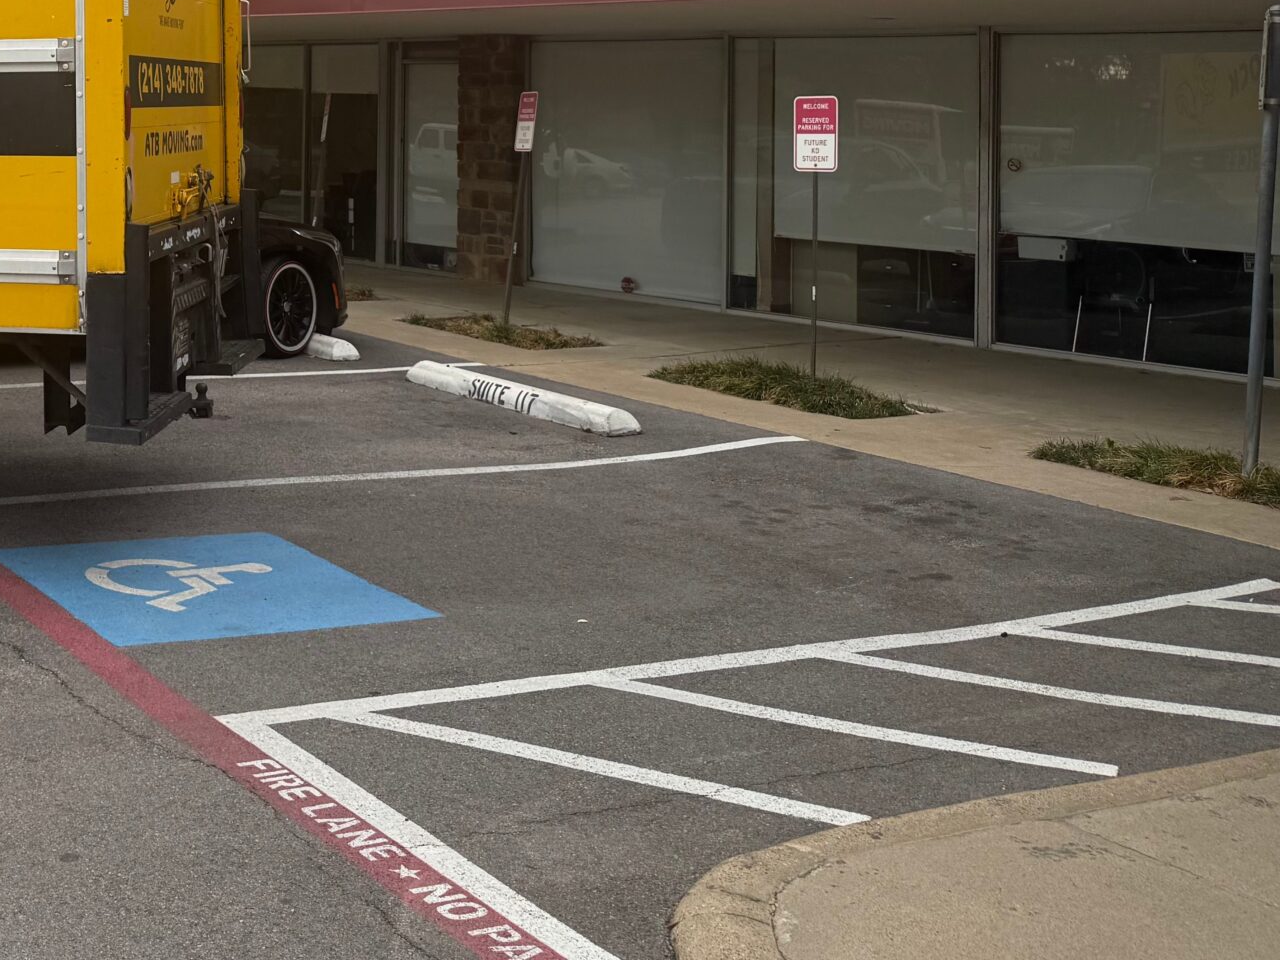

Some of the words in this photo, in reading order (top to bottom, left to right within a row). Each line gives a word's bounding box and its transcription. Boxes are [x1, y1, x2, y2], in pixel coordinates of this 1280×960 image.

[138, 62, 164, 102] (214)
[166, 64, 204, 94] 348-7878
[145, 132, 160, 157] ATB
[162, 129, 203, 155] MOVING.com
[802, 155, 829, 163] STUDENT
[470, 378, 511, 405] SUITE
[515, 390, 540, 414] 117
[236, 758, 322, 802] FIRE
[300, 802, 407, 862] LANE
[408, 882, 489, 921] NO
